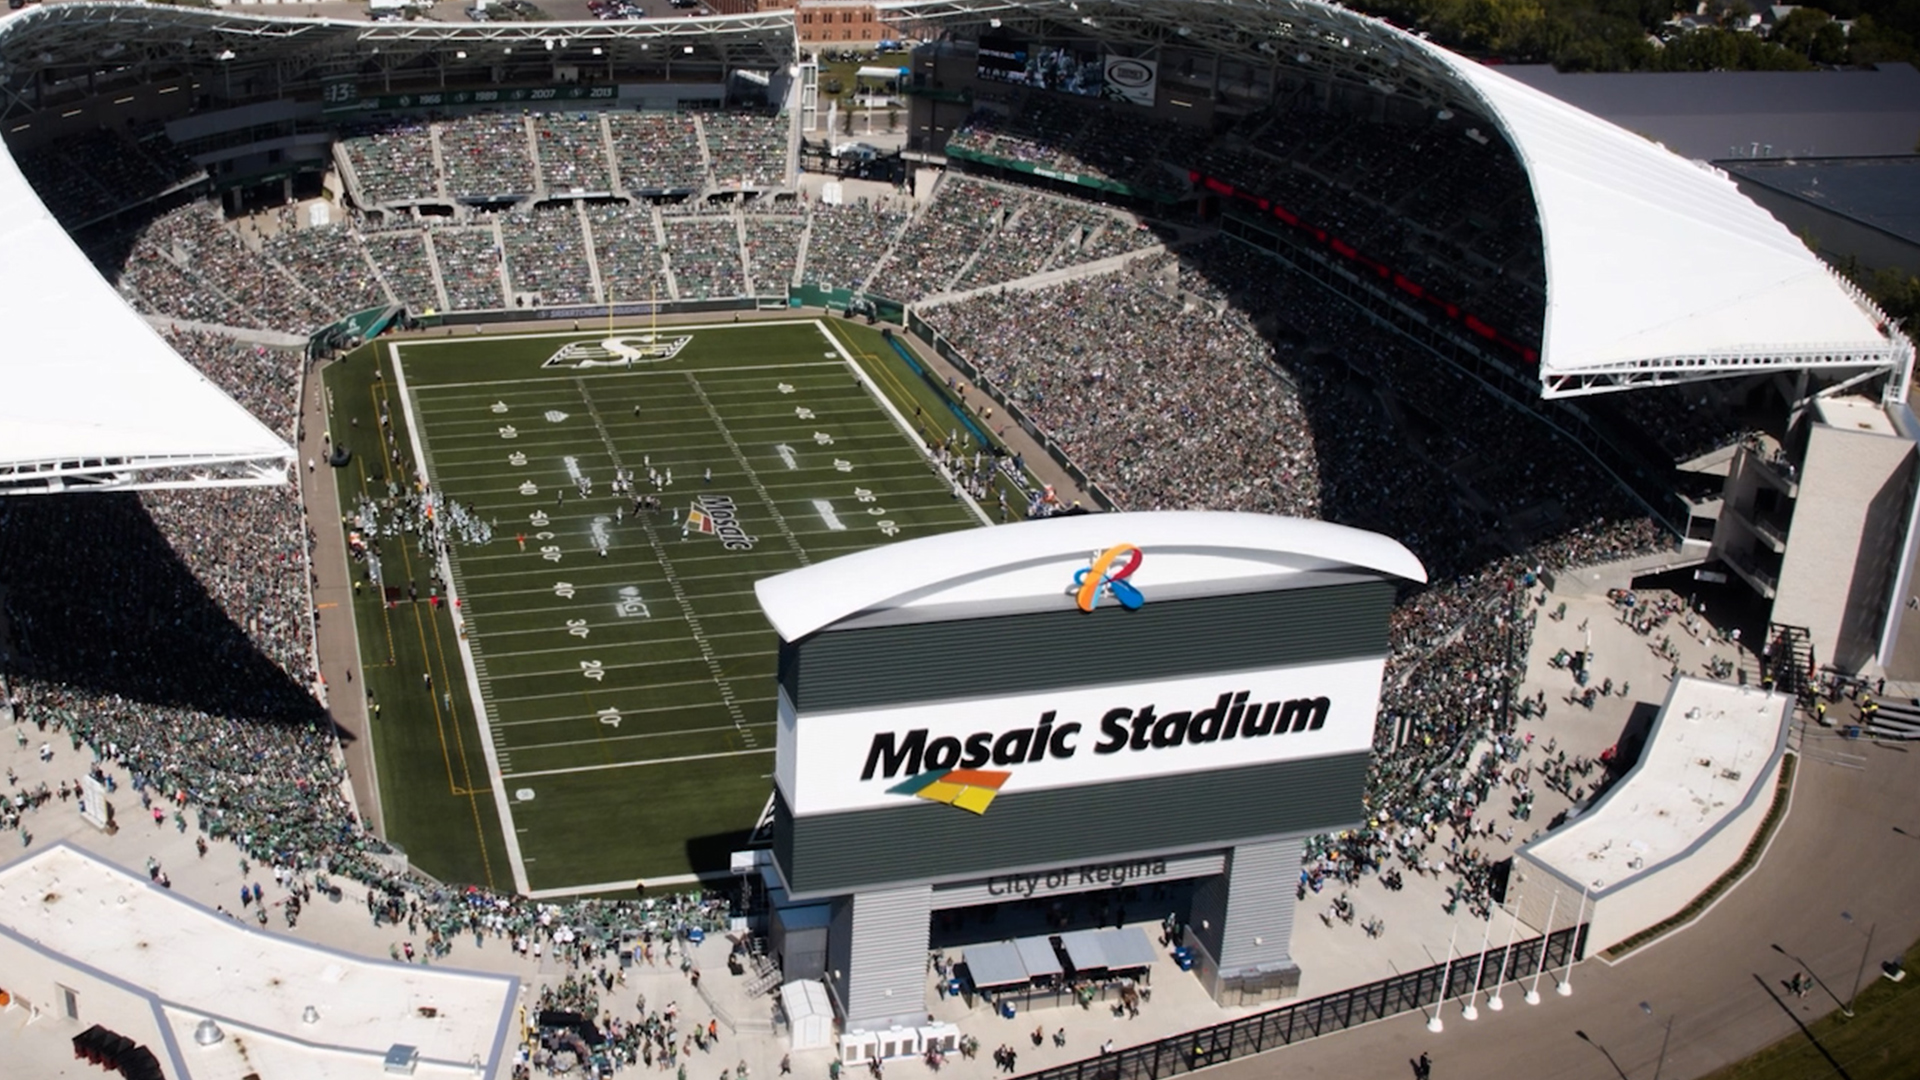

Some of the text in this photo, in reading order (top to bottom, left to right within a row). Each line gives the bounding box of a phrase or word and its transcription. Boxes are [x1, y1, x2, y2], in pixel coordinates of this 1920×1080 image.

[331, 83, 350, 102] 13
[475, 91, 499, 101] 1989
[531, 89, 556, 99] 2007
[590, 88, 612, 98] 2013
[529, 510, 550, 527] 50
[867, 507, 886, 516] C
[698, 494, 758, 550] Mosaic
[536, 532, 555, 540] C
[540, 545, 562, 563] 50
[553, 581, 576, 599] 40
[620, 596, 651, 618] AGT
[566, 619, 590, 638] 30
[580, 660, 605, 681] 20
[597, 707, 622, 727] 10
[861, 690, 1331, 782] Mosaic Stadium
[988, 859, 1167, 897] City of Regina
